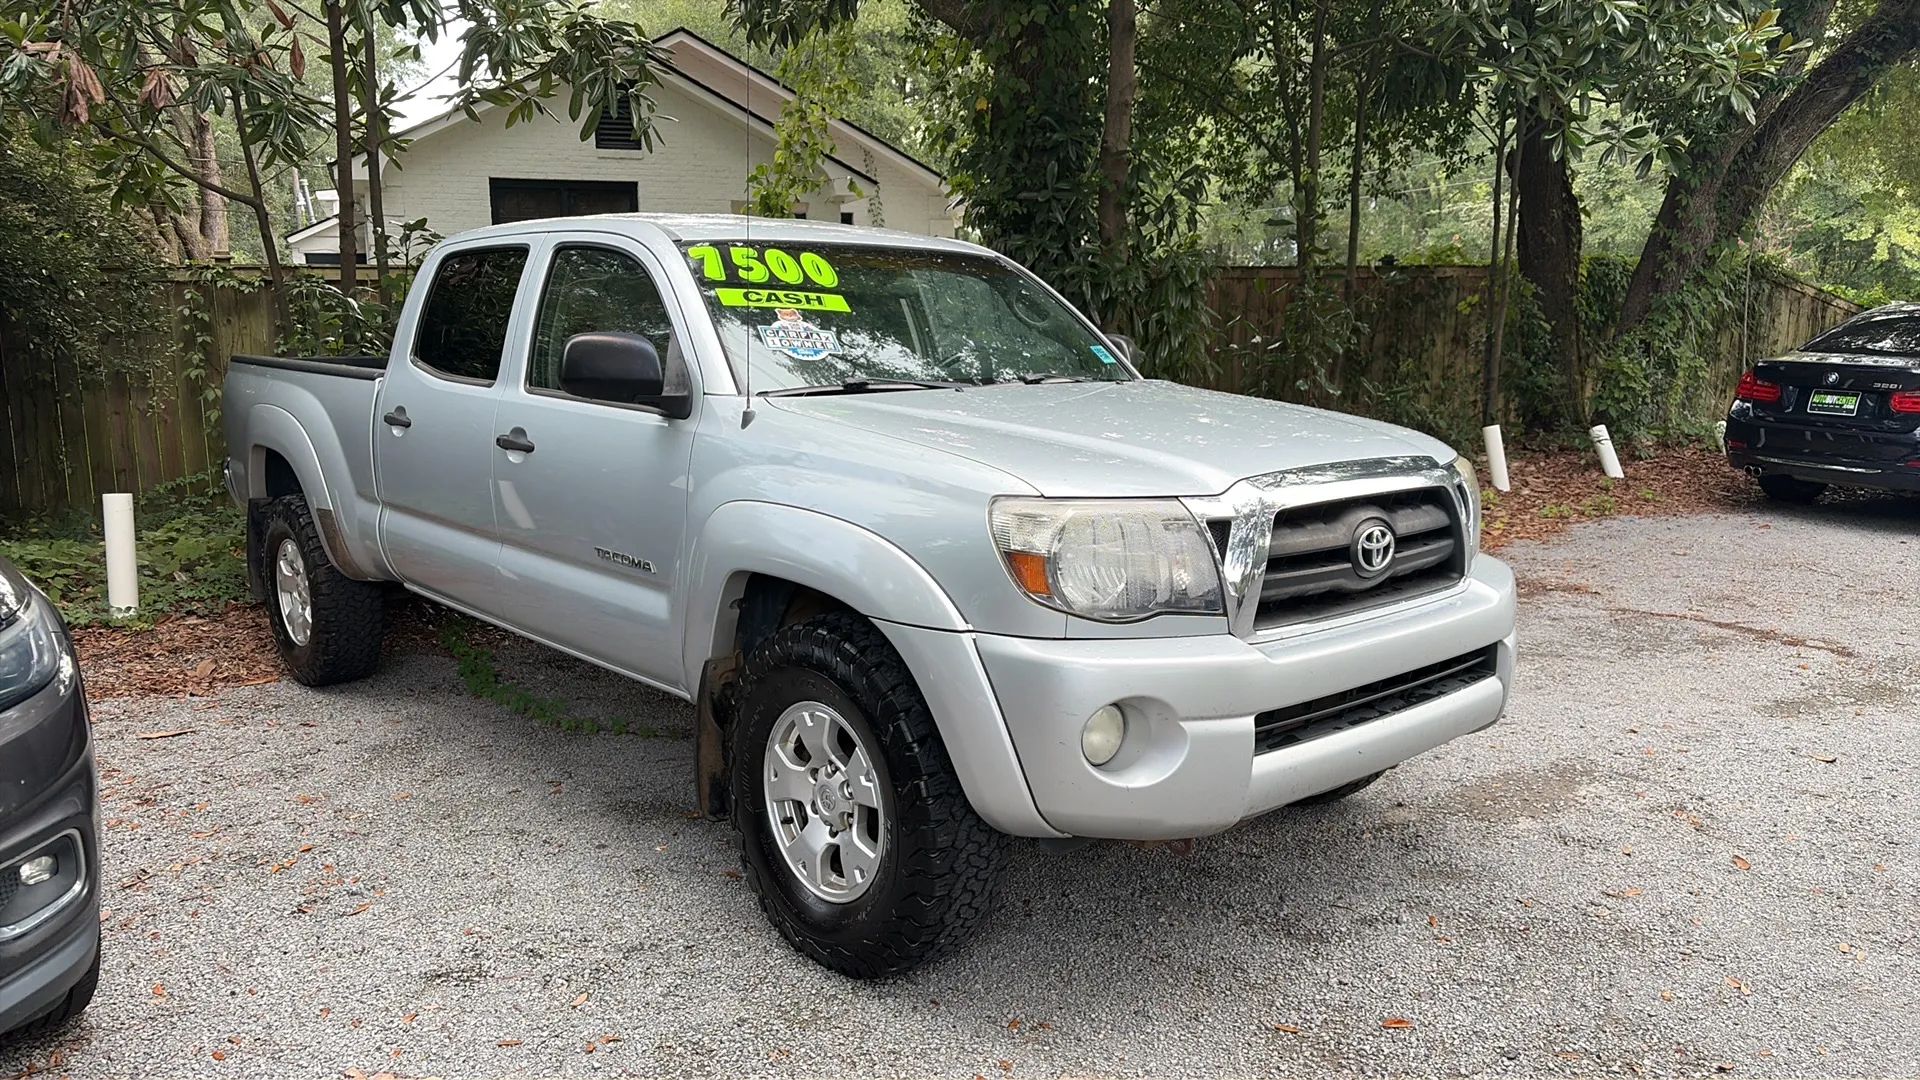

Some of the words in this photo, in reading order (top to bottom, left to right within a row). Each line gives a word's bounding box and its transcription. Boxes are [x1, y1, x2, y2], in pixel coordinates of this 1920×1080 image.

[687, 245, 838, 288] 7500
[742, 290, 824, 306] CASH
[765, 329, 831, 342] CARFAX
[780, 339, 836, 351] OWNER
[594, 545, 656, 574] TACOMA
